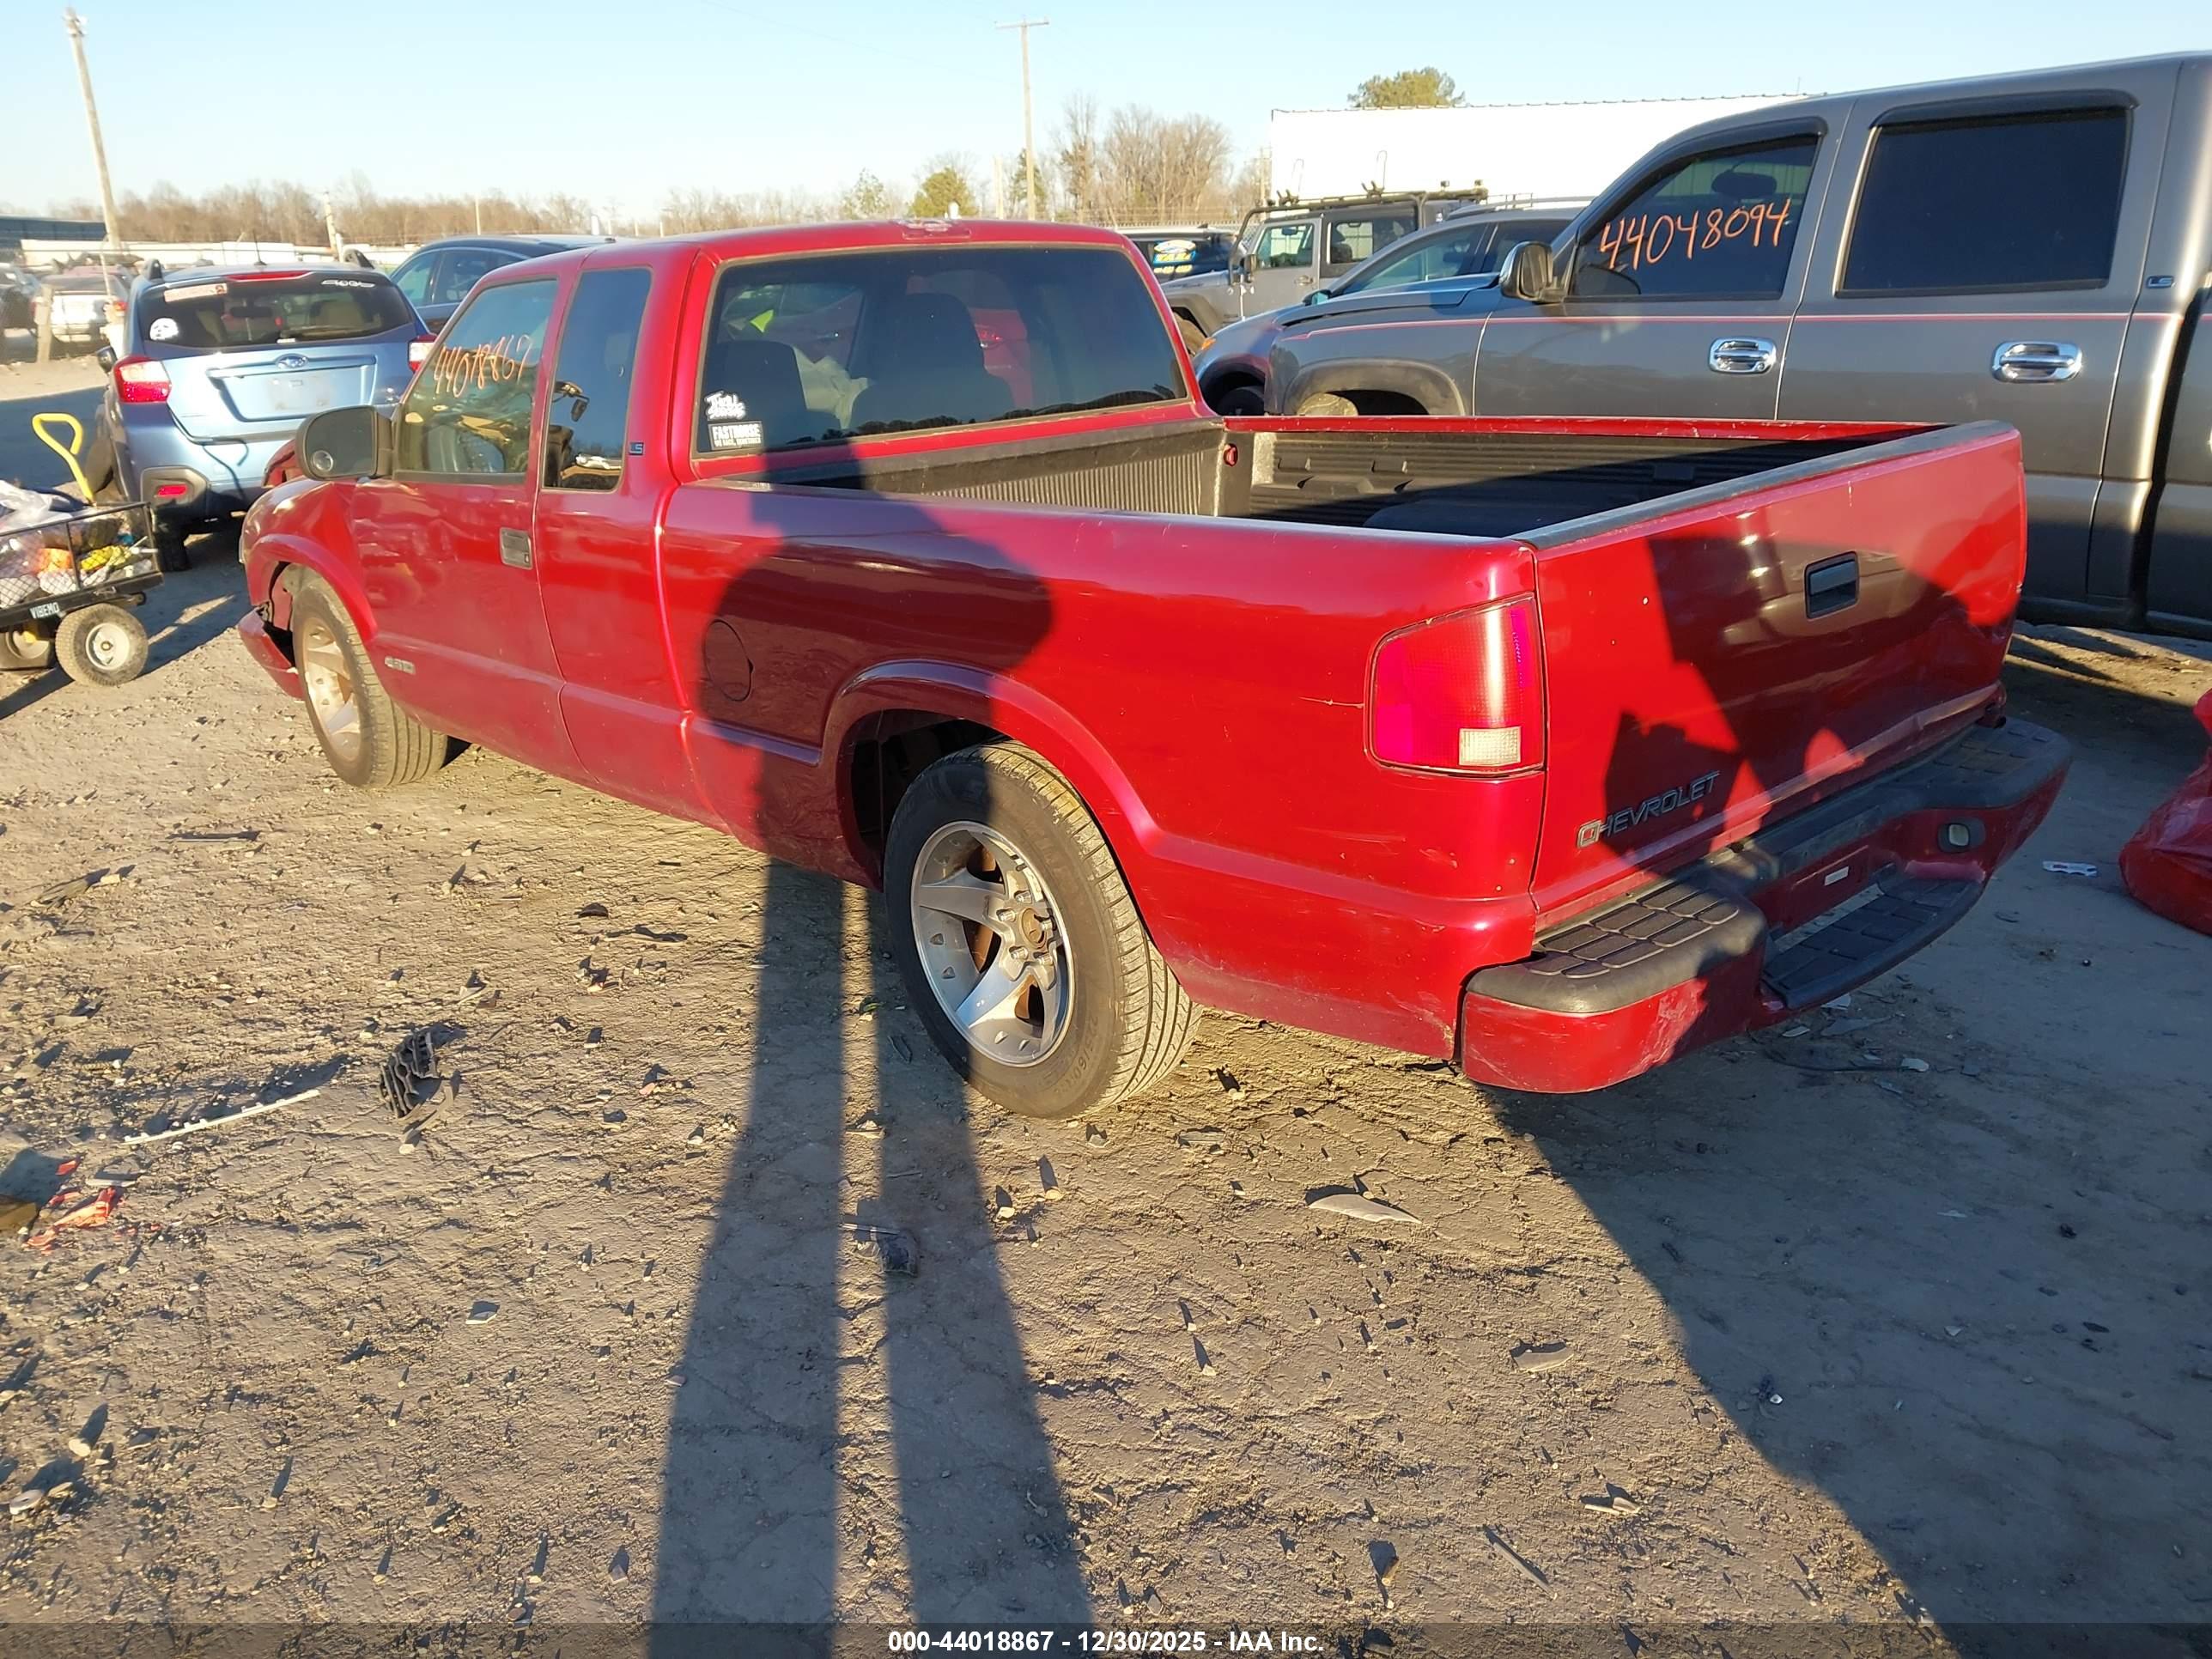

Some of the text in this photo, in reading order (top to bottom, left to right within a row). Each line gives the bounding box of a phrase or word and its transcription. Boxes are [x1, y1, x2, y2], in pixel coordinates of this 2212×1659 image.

[1599, 197, 1792, 271] 44048094
[2148, 277, 2172, 287] LS
[433, 333, 533, 398] 44018867
[1577, 770, 1721, 849] CHEVROLET
